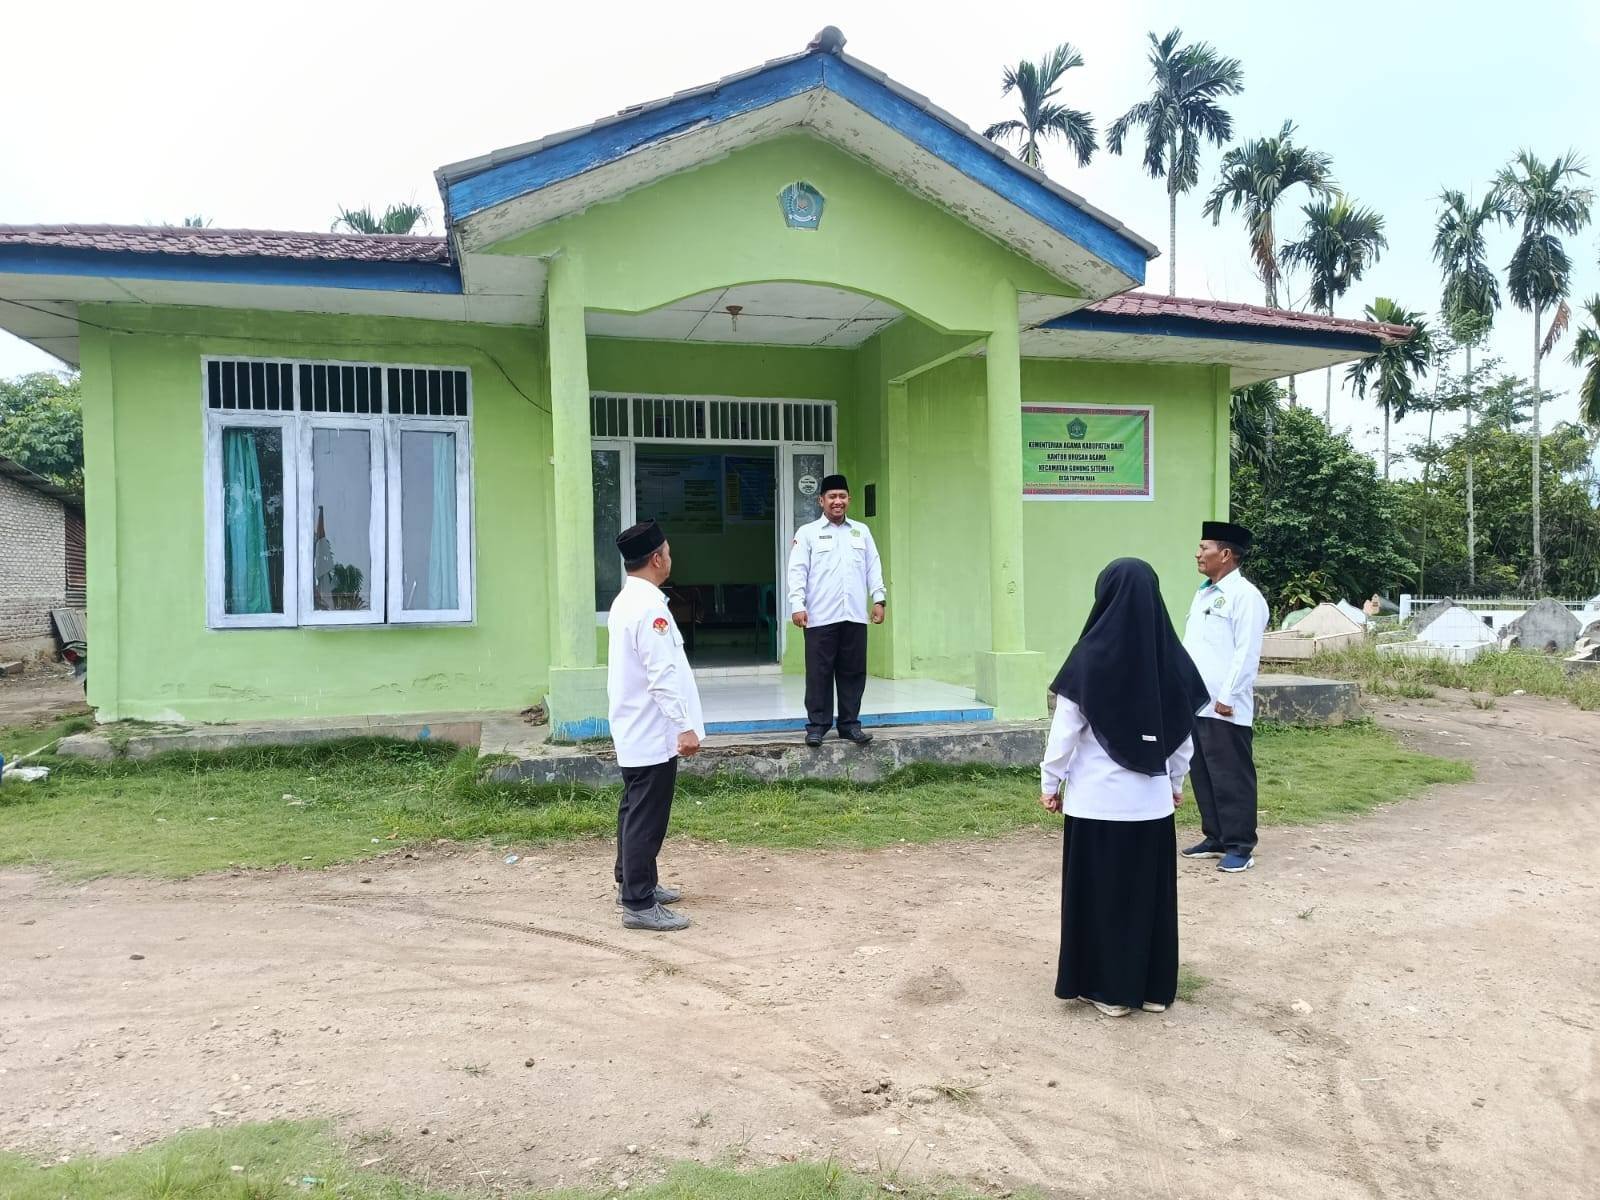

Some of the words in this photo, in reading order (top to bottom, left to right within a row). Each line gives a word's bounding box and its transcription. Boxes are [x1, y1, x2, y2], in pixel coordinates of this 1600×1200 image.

[1028, 441, 1062, 449] KEMENTERIAN
[1082, 442, 1110, 450] KABUPATEN
[1068, 453, 1088, 461] URUSAN
[1089, 453, 1106, 461] AGAMA
